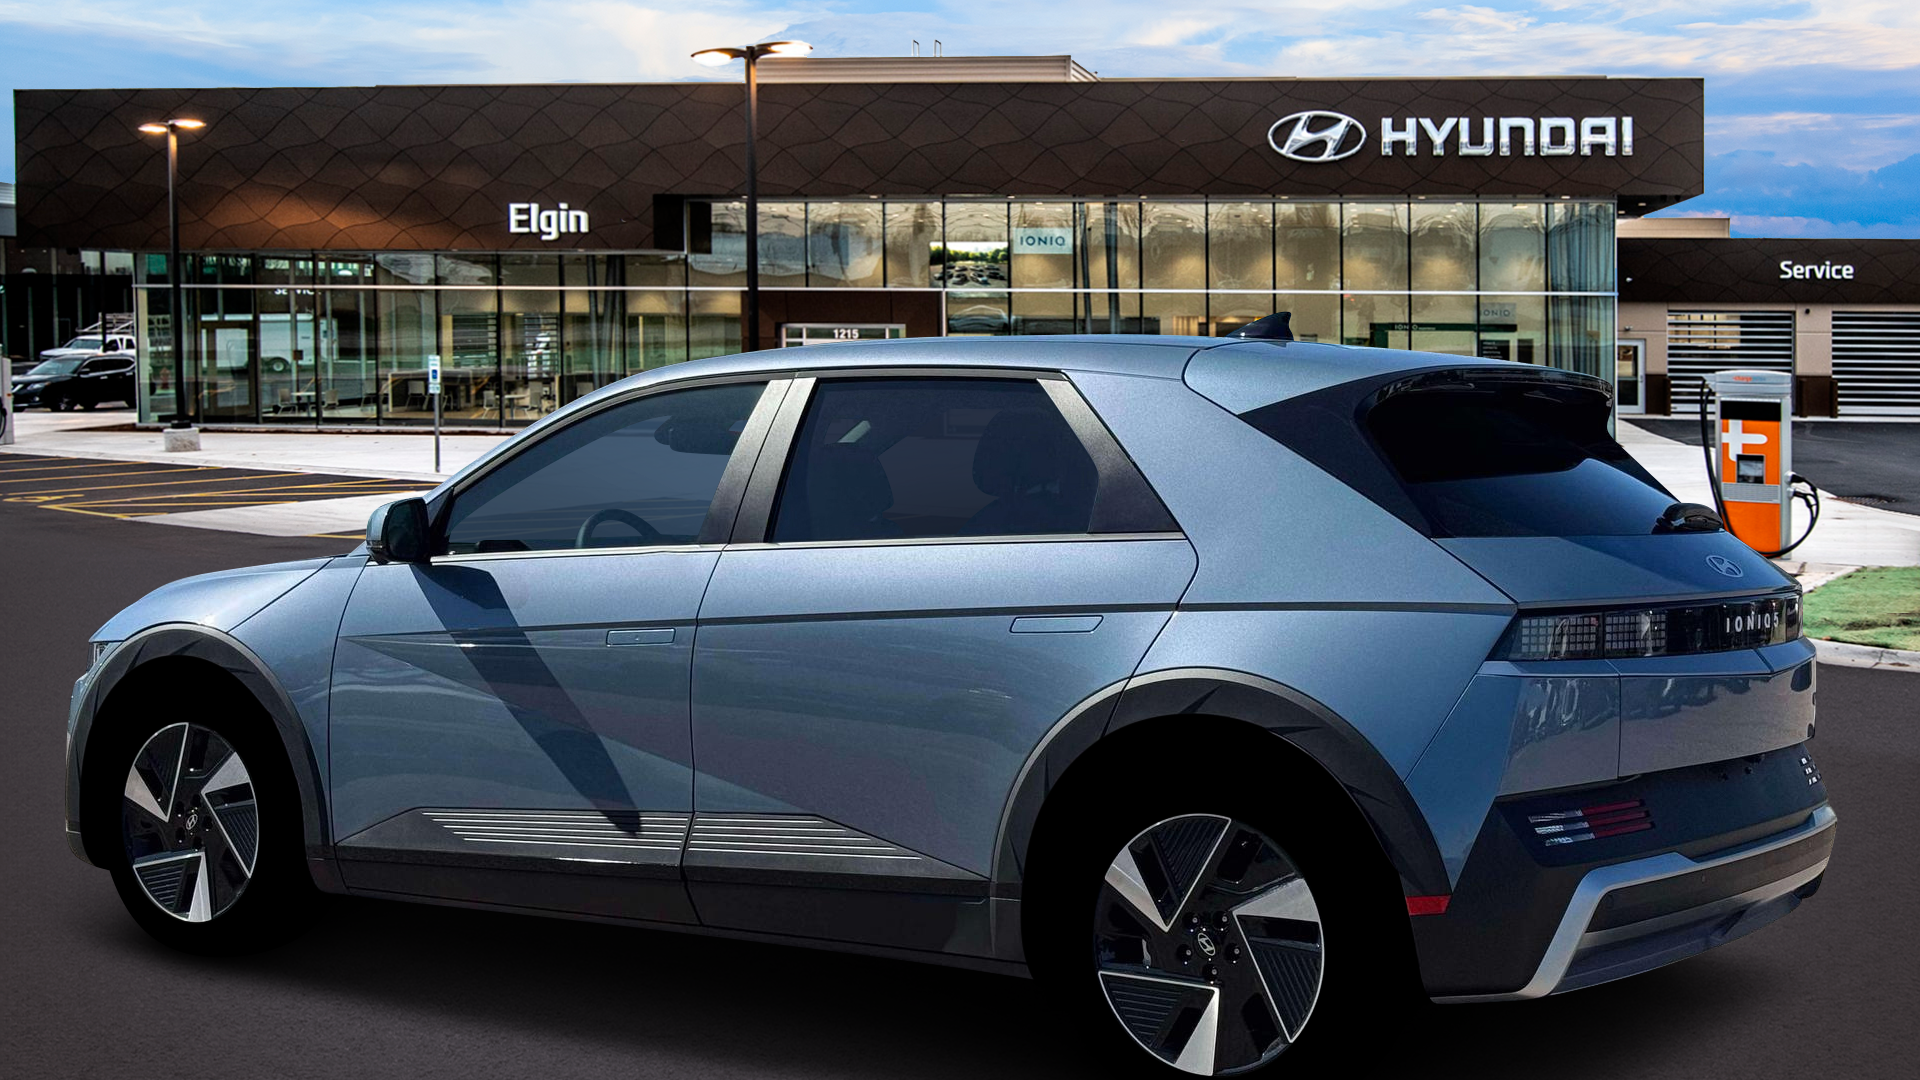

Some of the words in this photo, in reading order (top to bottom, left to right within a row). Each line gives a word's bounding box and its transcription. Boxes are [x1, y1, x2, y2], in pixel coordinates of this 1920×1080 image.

[1380, 117, 1633, 157] HYUNDAI
[509, 202, 590, 241] Elgin
[1020, 235, 1066, 247] IONIQ
[1779, 260, 1855, 280] Service
[833, 328, 859, 339] 1215
